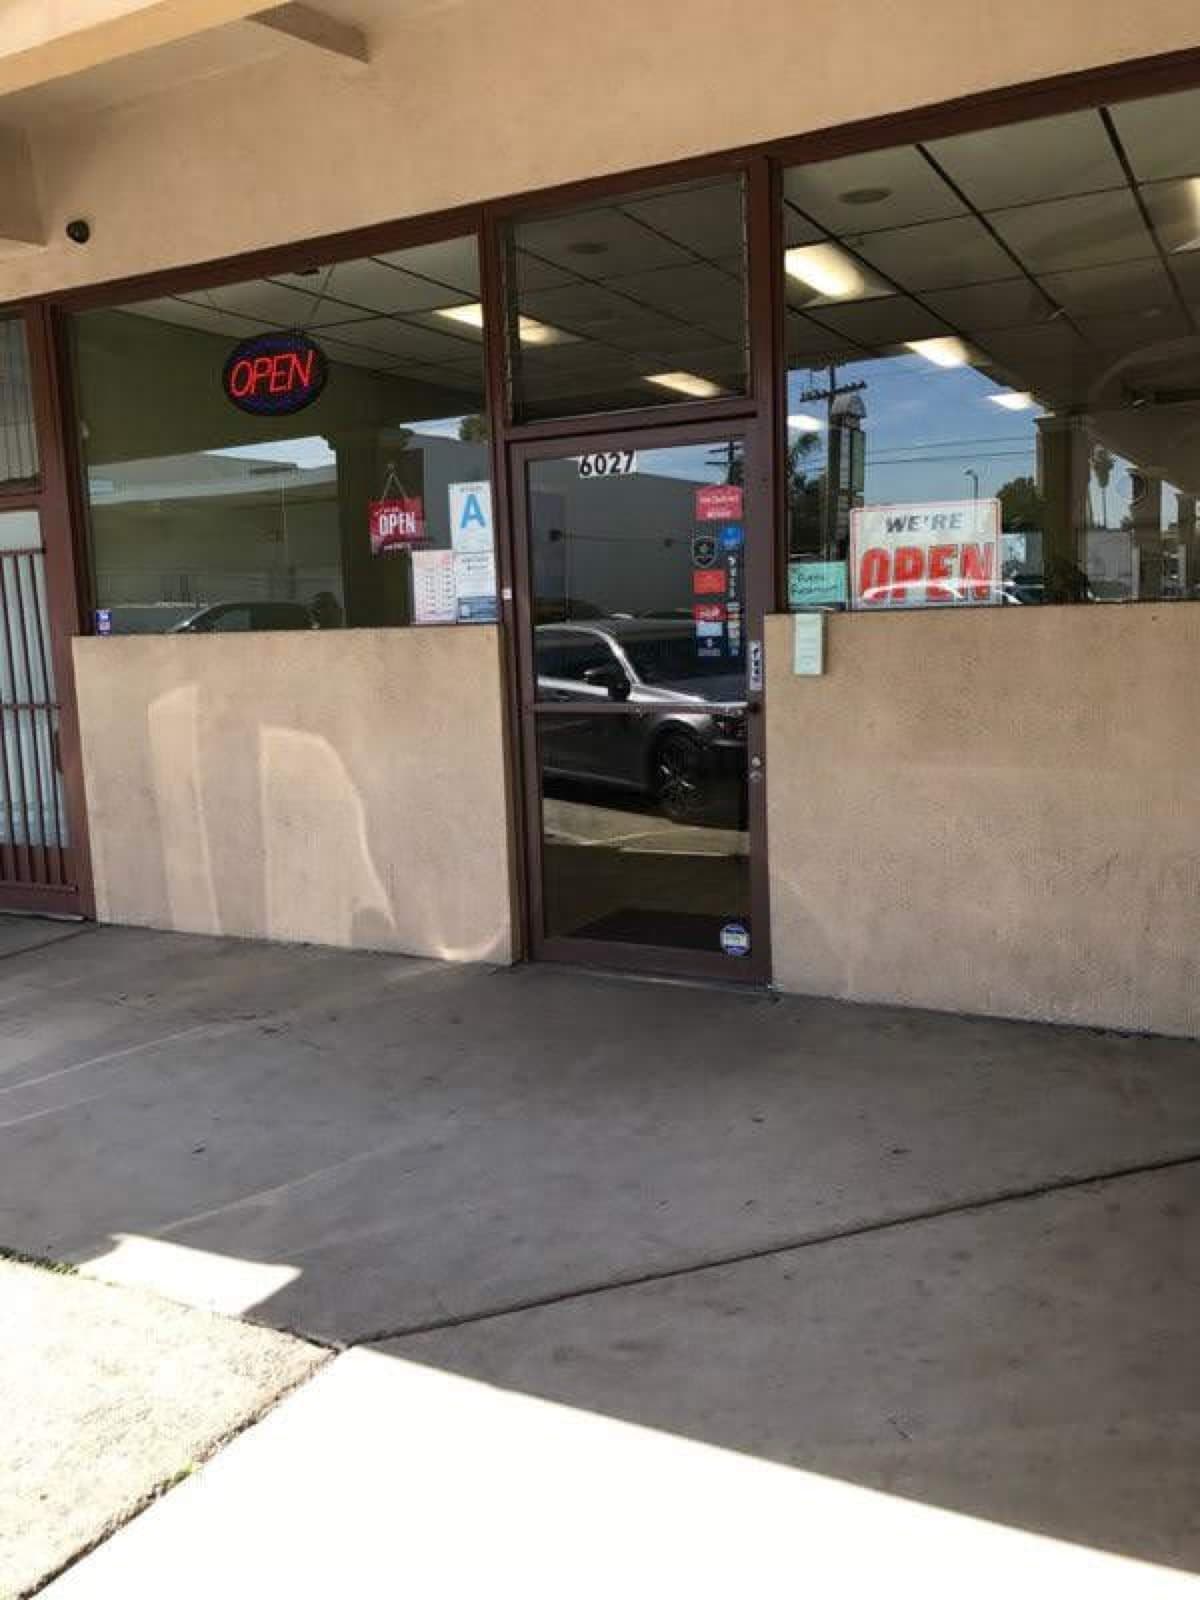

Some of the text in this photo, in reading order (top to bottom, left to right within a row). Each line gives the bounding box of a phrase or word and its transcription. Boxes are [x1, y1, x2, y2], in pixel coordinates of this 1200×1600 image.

[230, 349, 316, 397] OPEN
[579, 449, 634, 474] 6027
[379, 511, 416, 535] OPEN
[460, 493, 486, 529] A
[885, 511, 964, 533] WE'RE
[859, 543, 993, 605] OPEN
